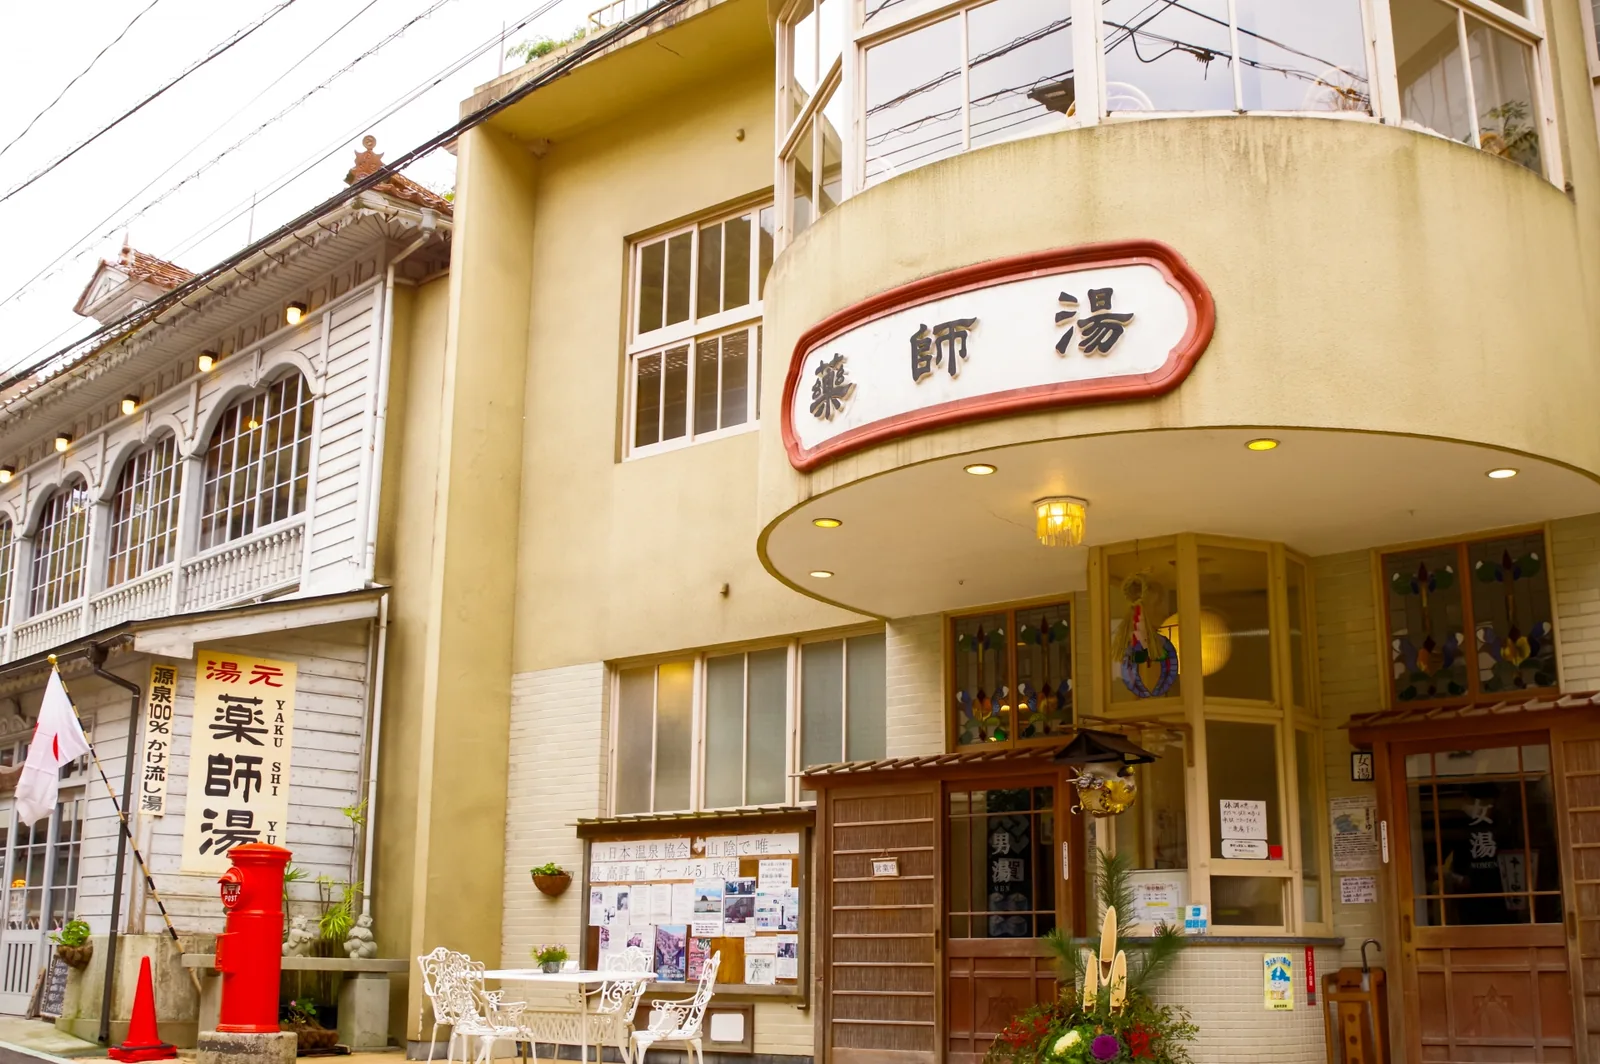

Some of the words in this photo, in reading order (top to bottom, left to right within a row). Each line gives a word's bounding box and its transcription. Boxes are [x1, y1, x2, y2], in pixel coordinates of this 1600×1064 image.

[206, 660, 284, 688] 湯元
[273, 700, 286, 748] YAKU
[199, 693, 269, 856] 薬師湯
[270, 762, 282, 796] SHI
[266, 821, 278, 845] YU
[1468, 798, 1497, 859] 女湯
[991, 832, 1011, 883] 男湯
